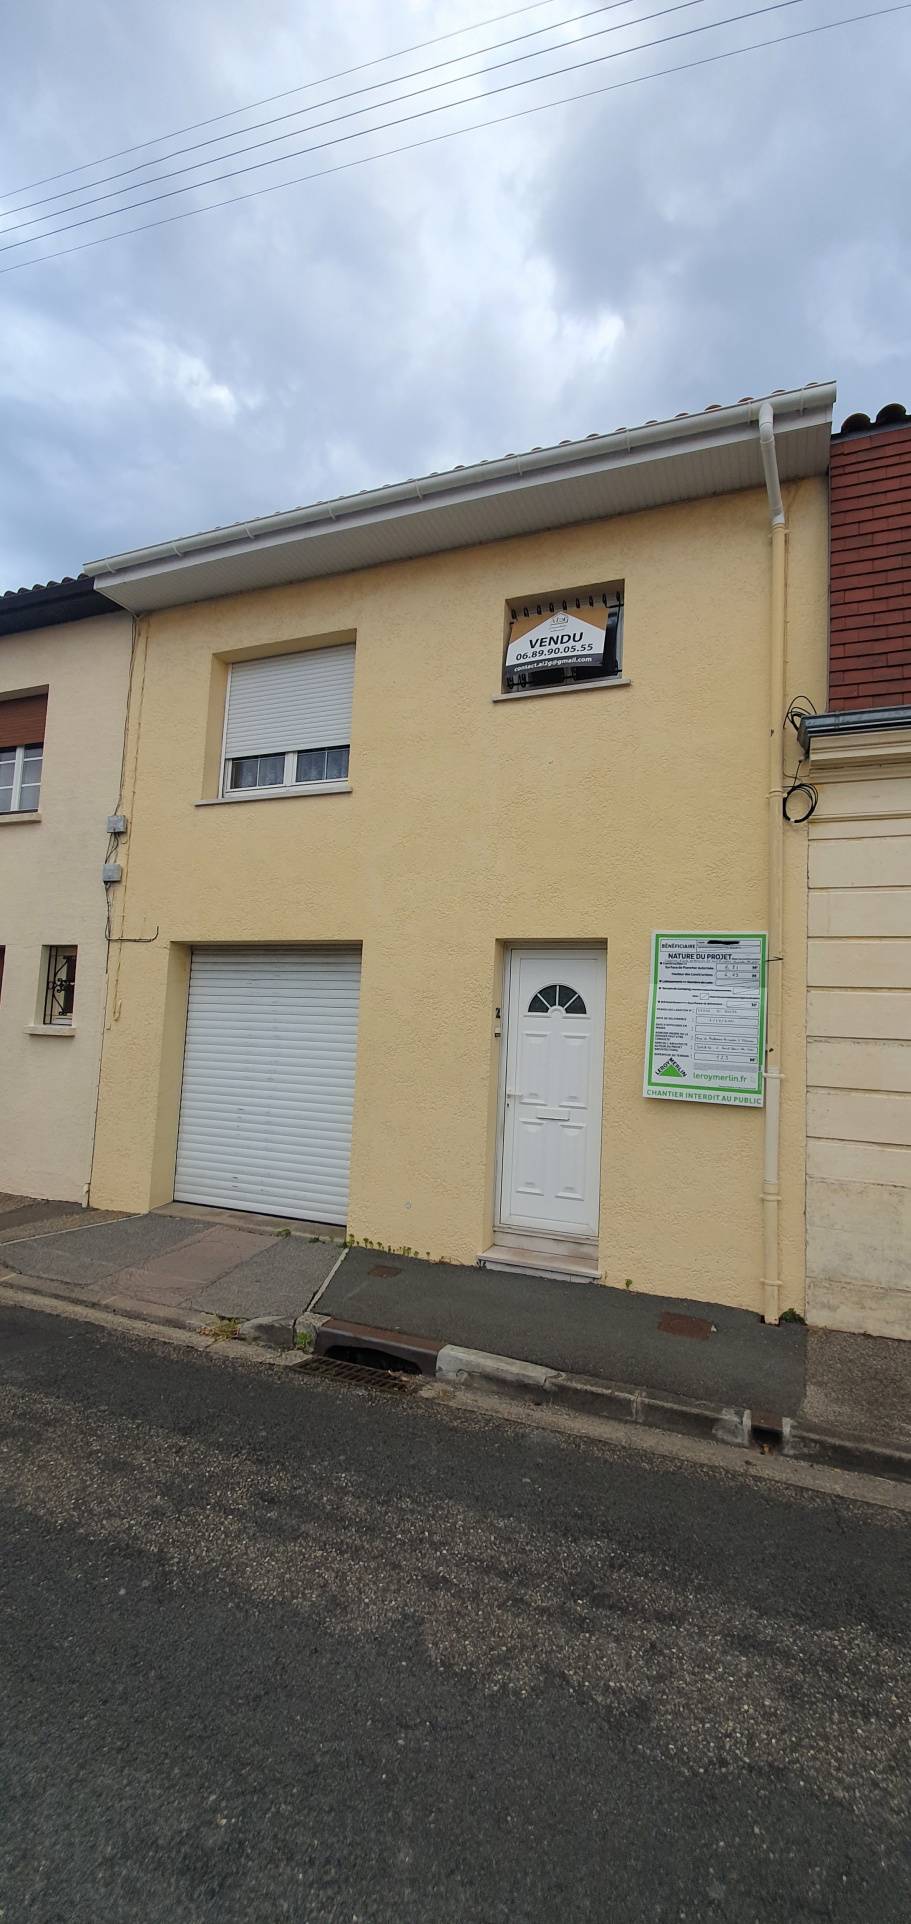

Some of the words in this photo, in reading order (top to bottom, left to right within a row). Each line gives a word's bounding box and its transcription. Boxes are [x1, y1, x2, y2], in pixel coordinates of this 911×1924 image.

[529, 632, 584, 649] VENDU
[515, 643, 593, 661] 06.89.90.05.55
[655, 1061, 671, 1076] LEROY
[669, 1057, 687, 1077] MERLIN
[693, 1072, 747, 1083] leroymerlin.fr
[647, 1089, 684, 1098] CHANTIER
[685, 1092, 720, 1102] INTERDIT
[733, 1096, 761, 1105] PUBLIC
